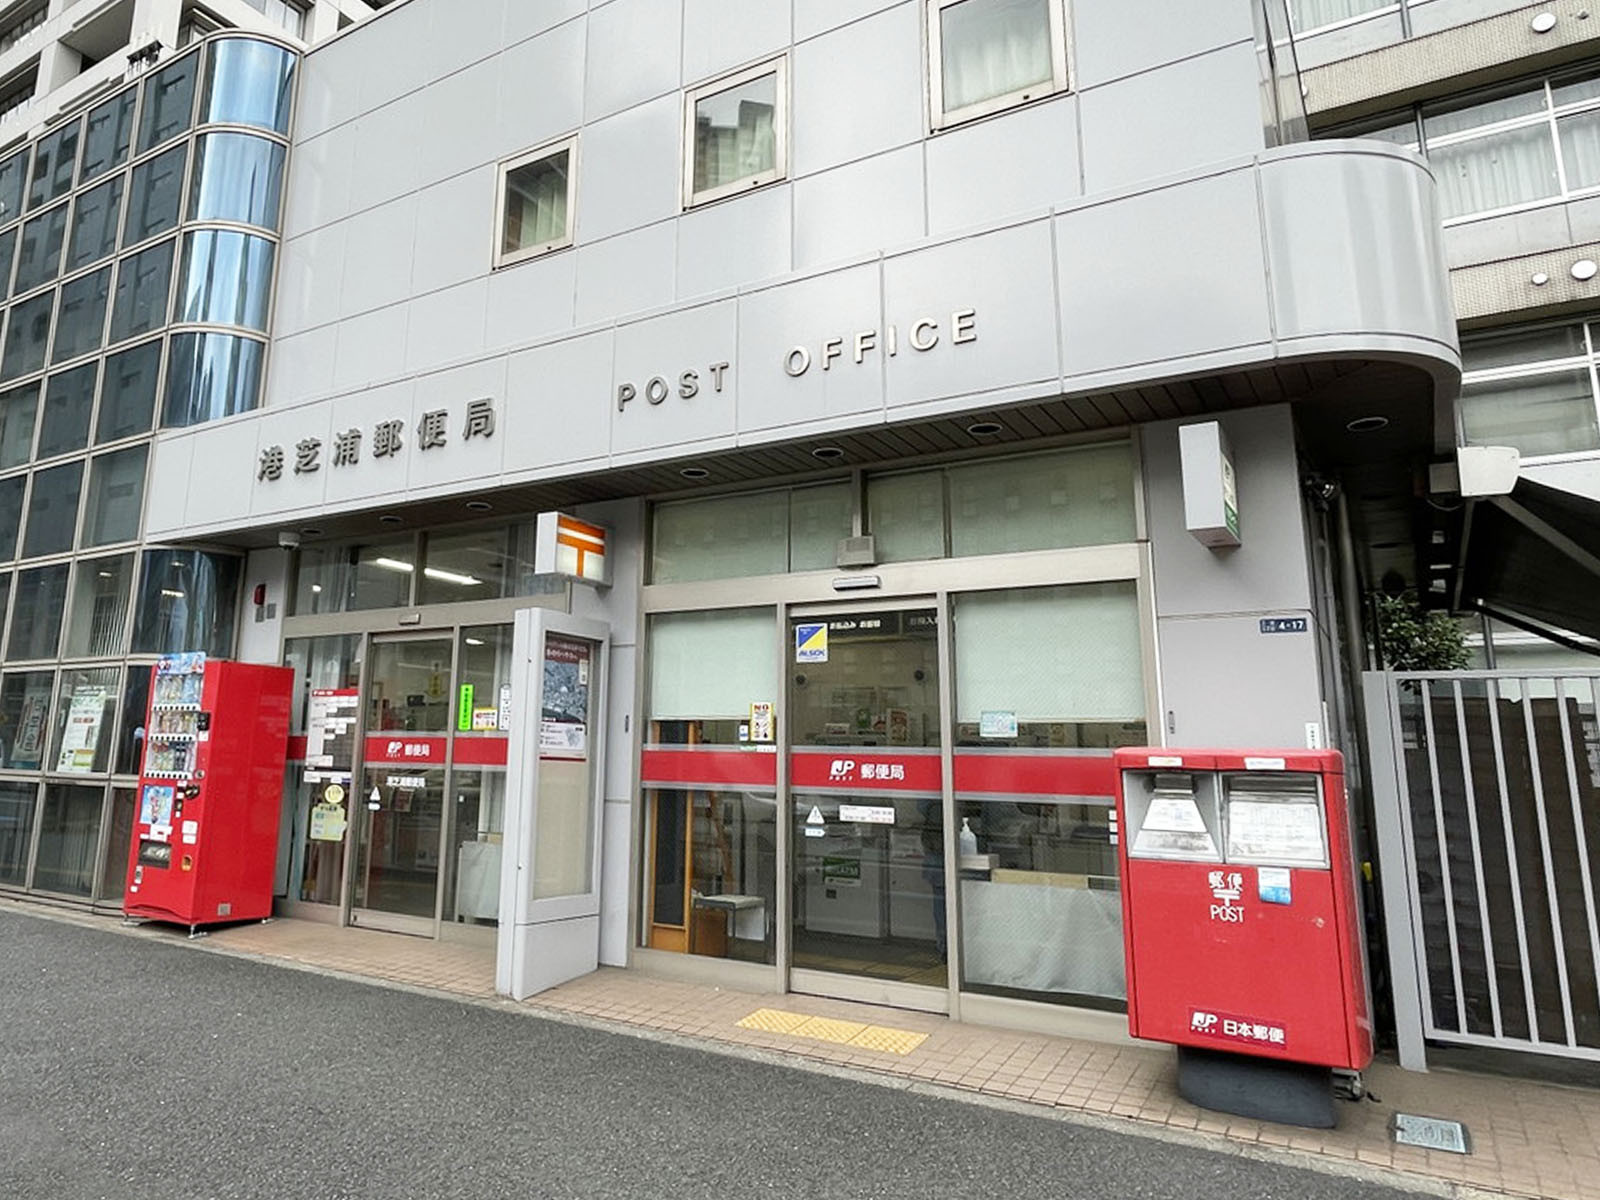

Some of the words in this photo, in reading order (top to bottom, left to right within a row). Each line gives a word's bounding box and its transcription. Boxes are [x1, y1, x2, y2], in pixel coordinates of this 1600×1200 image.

[617, 361, 729, 412] POST
[783, 308, 977, 377] OFFICE
[257, 398, 496, 482] 港芝浦郵便局
[860, 763, 905, 781] 郵便局
[1208, 870, 1244, 892] 郵便
[1209, 904, 1245, 923] POST
[1223, 1018, 1286, 1045] 日本郵便
